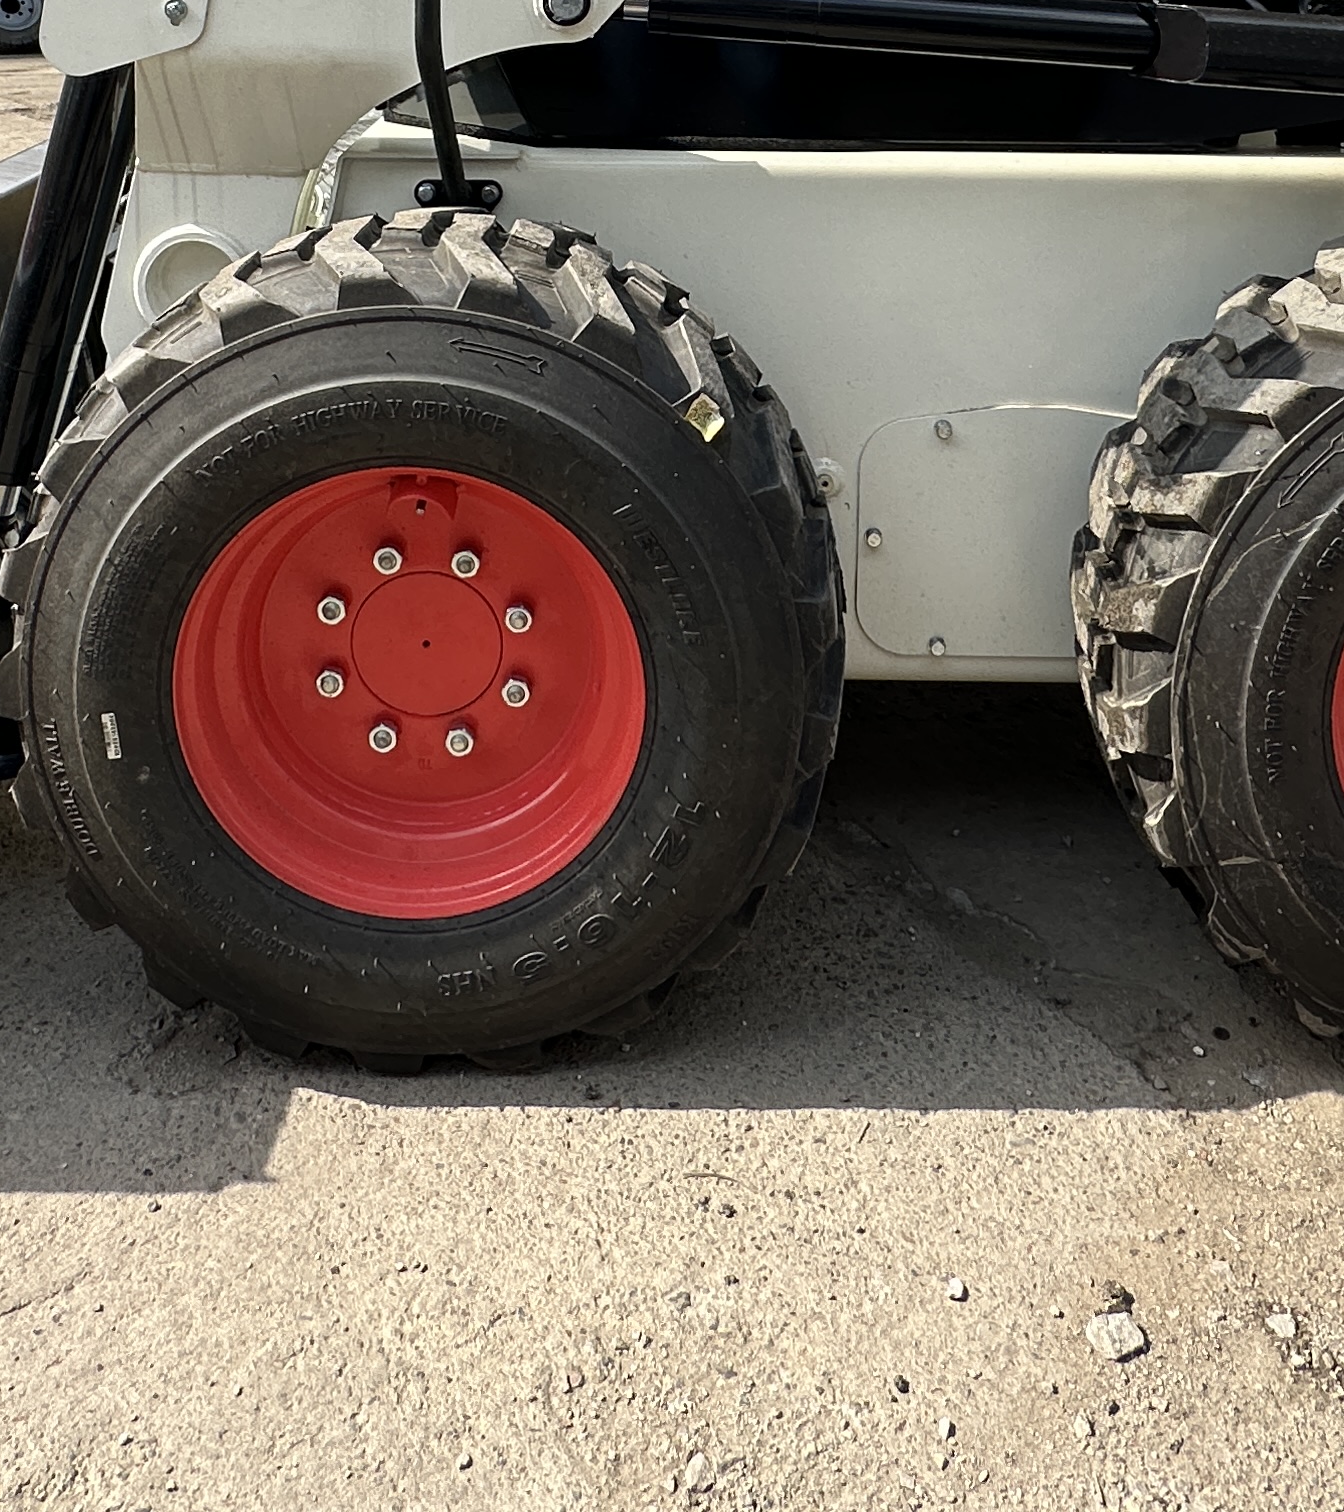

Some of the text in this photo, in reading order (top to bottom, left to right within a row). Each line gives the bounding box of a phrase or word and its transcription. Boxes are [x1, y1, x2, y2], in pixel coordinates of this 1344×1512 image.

[192, 398, 508, 486] NOT FOR HIGHWAY SERVICE
[512, 801, 706, 984] 12-16.5
